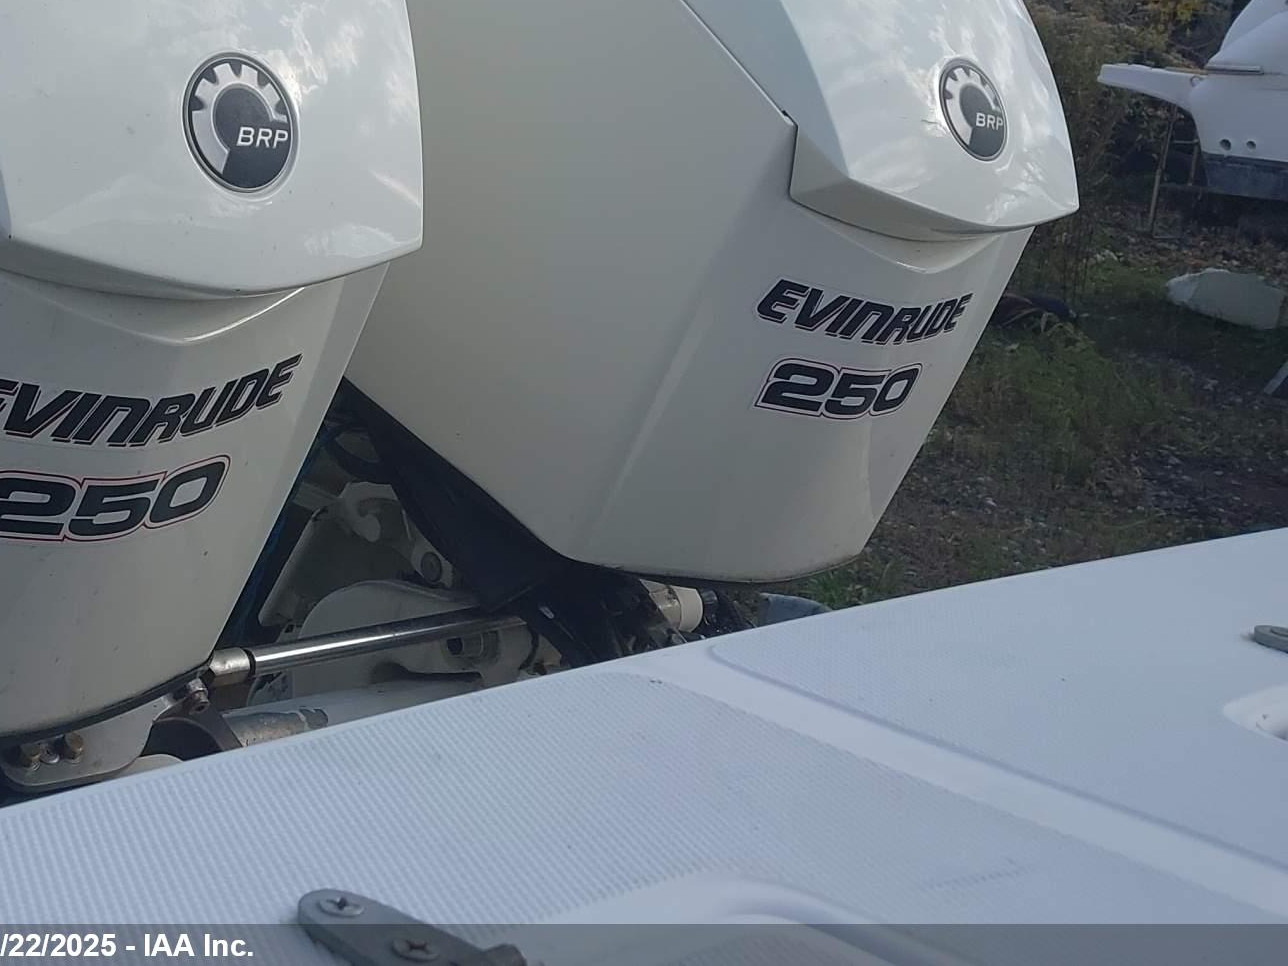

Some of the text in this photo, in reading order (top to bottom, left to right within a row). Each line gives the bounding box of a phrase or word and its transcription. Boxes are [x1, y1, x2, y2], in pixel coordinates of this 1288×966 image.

[236, 125, 289, 149] BRP
[975, 112, 1004, 132] BRP
[756, 278, 974, 346] EVINRUDE
[754, 357, 923, 420] 250
